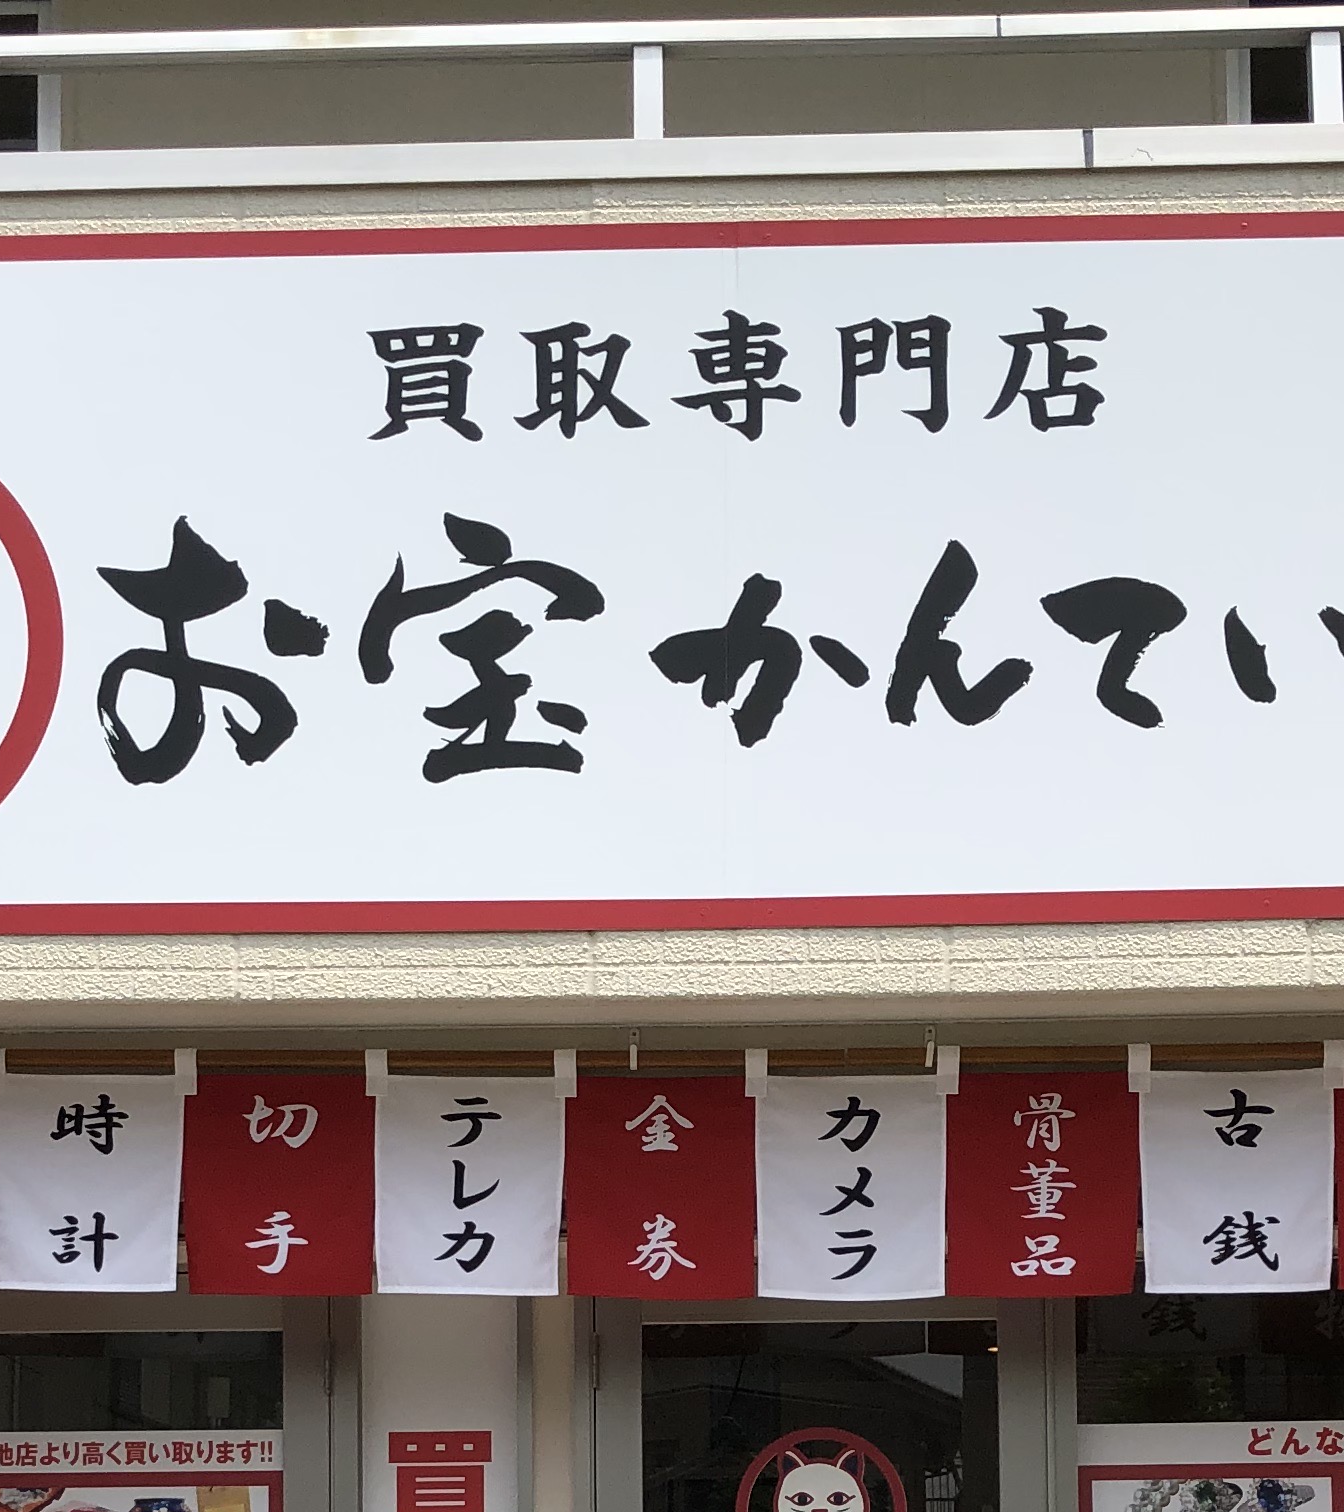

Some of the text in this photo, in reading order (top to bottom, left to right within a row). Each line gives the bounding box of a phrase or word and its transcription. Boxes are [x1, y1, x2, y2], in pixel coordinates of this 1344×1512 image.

[367, 306, 1109, 441] 買取専門店
[50, 1093, 128, 1273] 時計
[245, 1095, 317, 1274] 切手
[435, 1095, 502, 1274] テレカ
[625, 1094, 696, 1280] 金券
[819, 1096, 882, 1280] カメラ
[1011, 1093, 1077, 1278] 骨董品
[1204, 1090, 1279, 1271] 古銭
